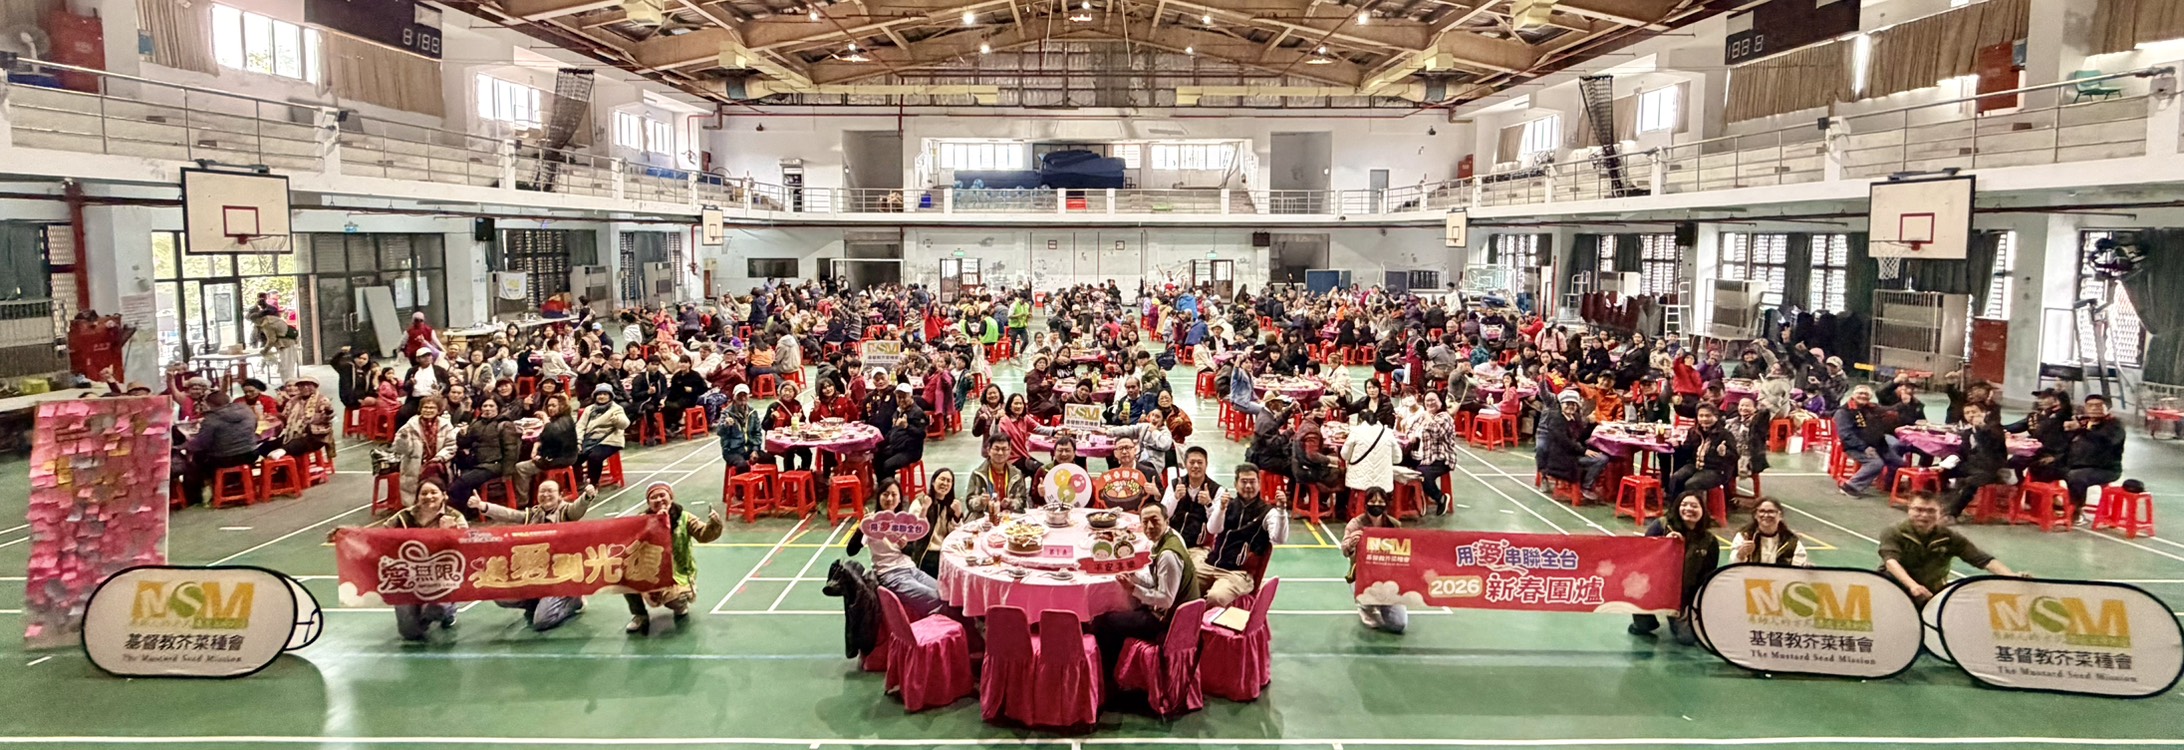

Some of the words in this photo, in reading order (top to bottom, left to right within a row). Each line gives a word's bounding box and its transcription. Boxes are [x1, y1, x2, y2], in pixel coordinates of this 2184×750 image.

[1456, 539, 1578, 569] 用愛串聯全台
[380, 557, 460, 591] 愛無限
[1430, 579, 1480, 596] 2026
[1485, 575, 1605, 604] 新春圍爐
[124, 633, 246, 651] 基督教芥菜種會
[1749, 630, 1874, 653] 基督教芥菜種會
[1751, 650, 1767, 658] The
[1771, 651, 1810, 661] Mustard
[1814, 653, 1835, 662] Seed
[1839, 655, 1876, 665] Mission
[1994, 646, 2133, 670] 基督教芥菜種會
